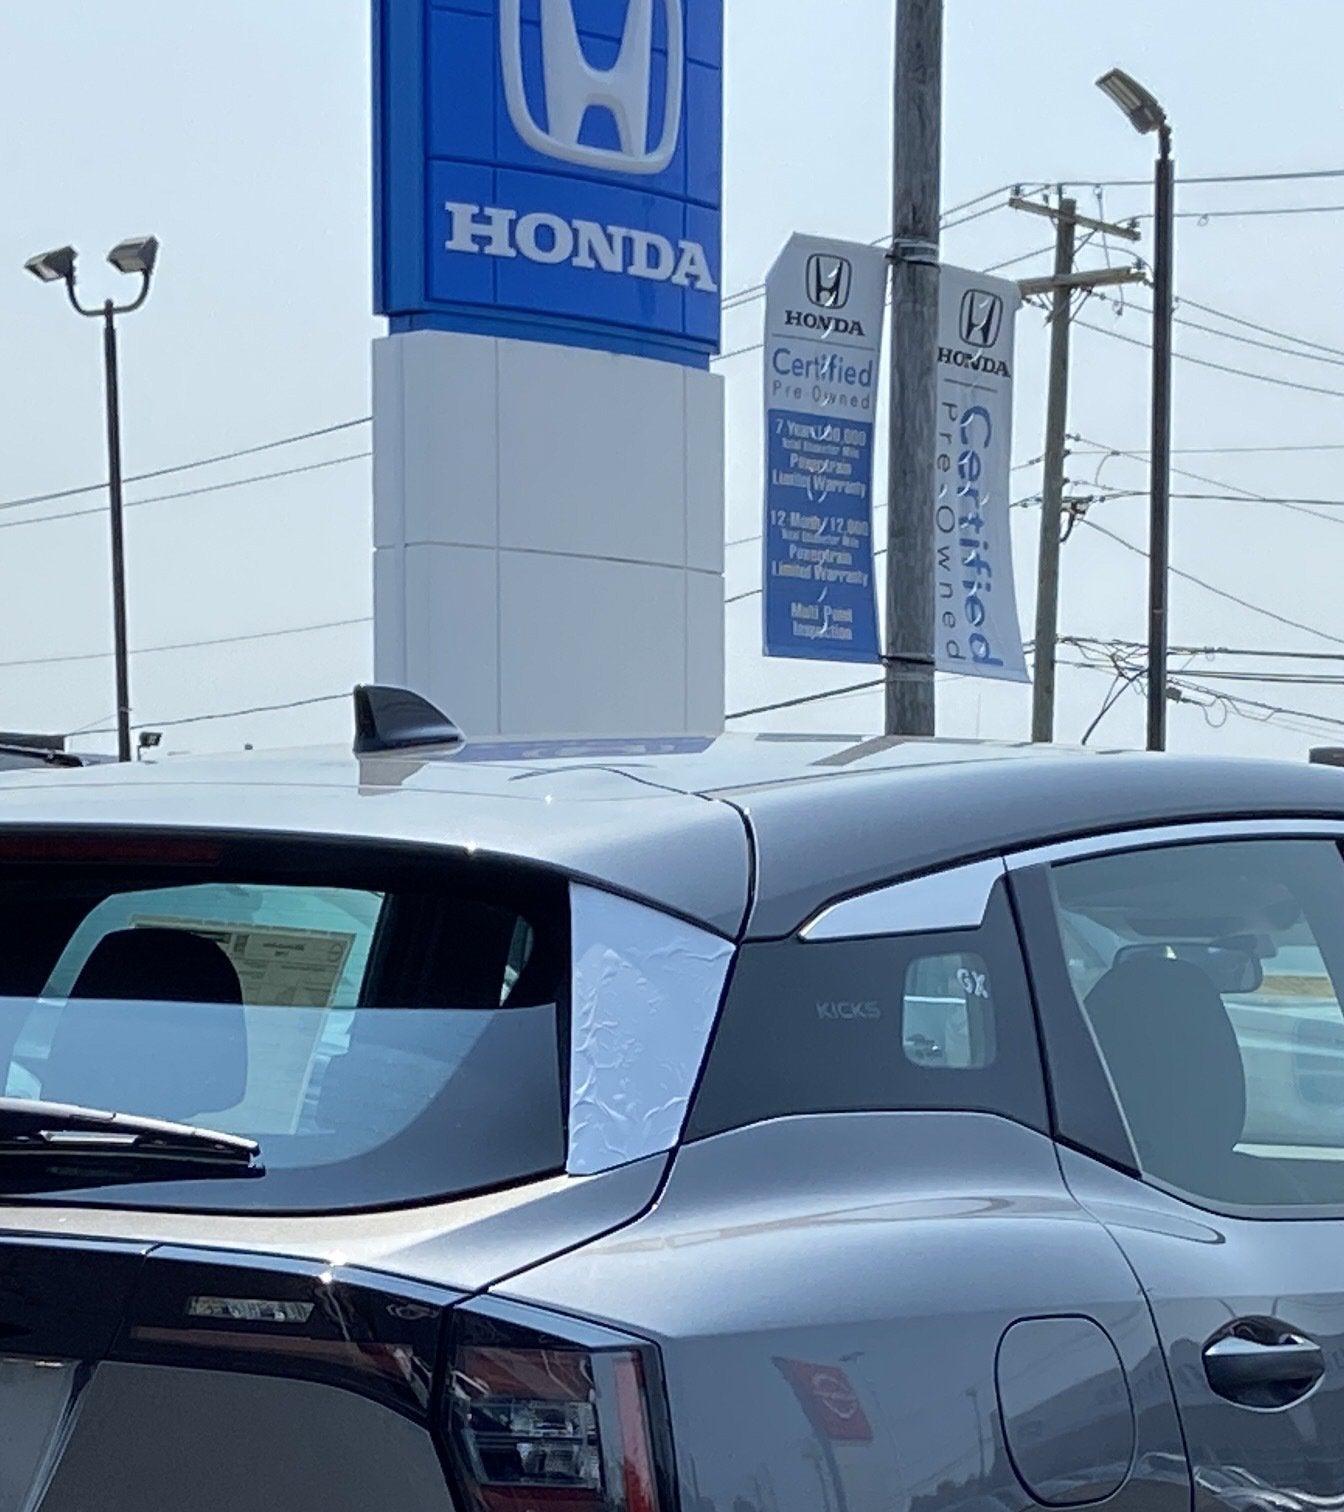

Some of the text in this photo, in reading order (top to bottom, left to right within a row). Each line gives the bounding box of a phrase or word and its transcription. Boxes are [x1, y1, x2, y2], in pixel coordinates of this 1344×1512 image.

[444, 201, 718, 293] HONDA
[784, 309, 865, 337] HONDA
[772, 347, 873, 388] Certified
[937, 346, 1011, 379] HONDA
[957, 405, 1004, 667] Certified
[816, 1002, 881, 1019] KICKS
